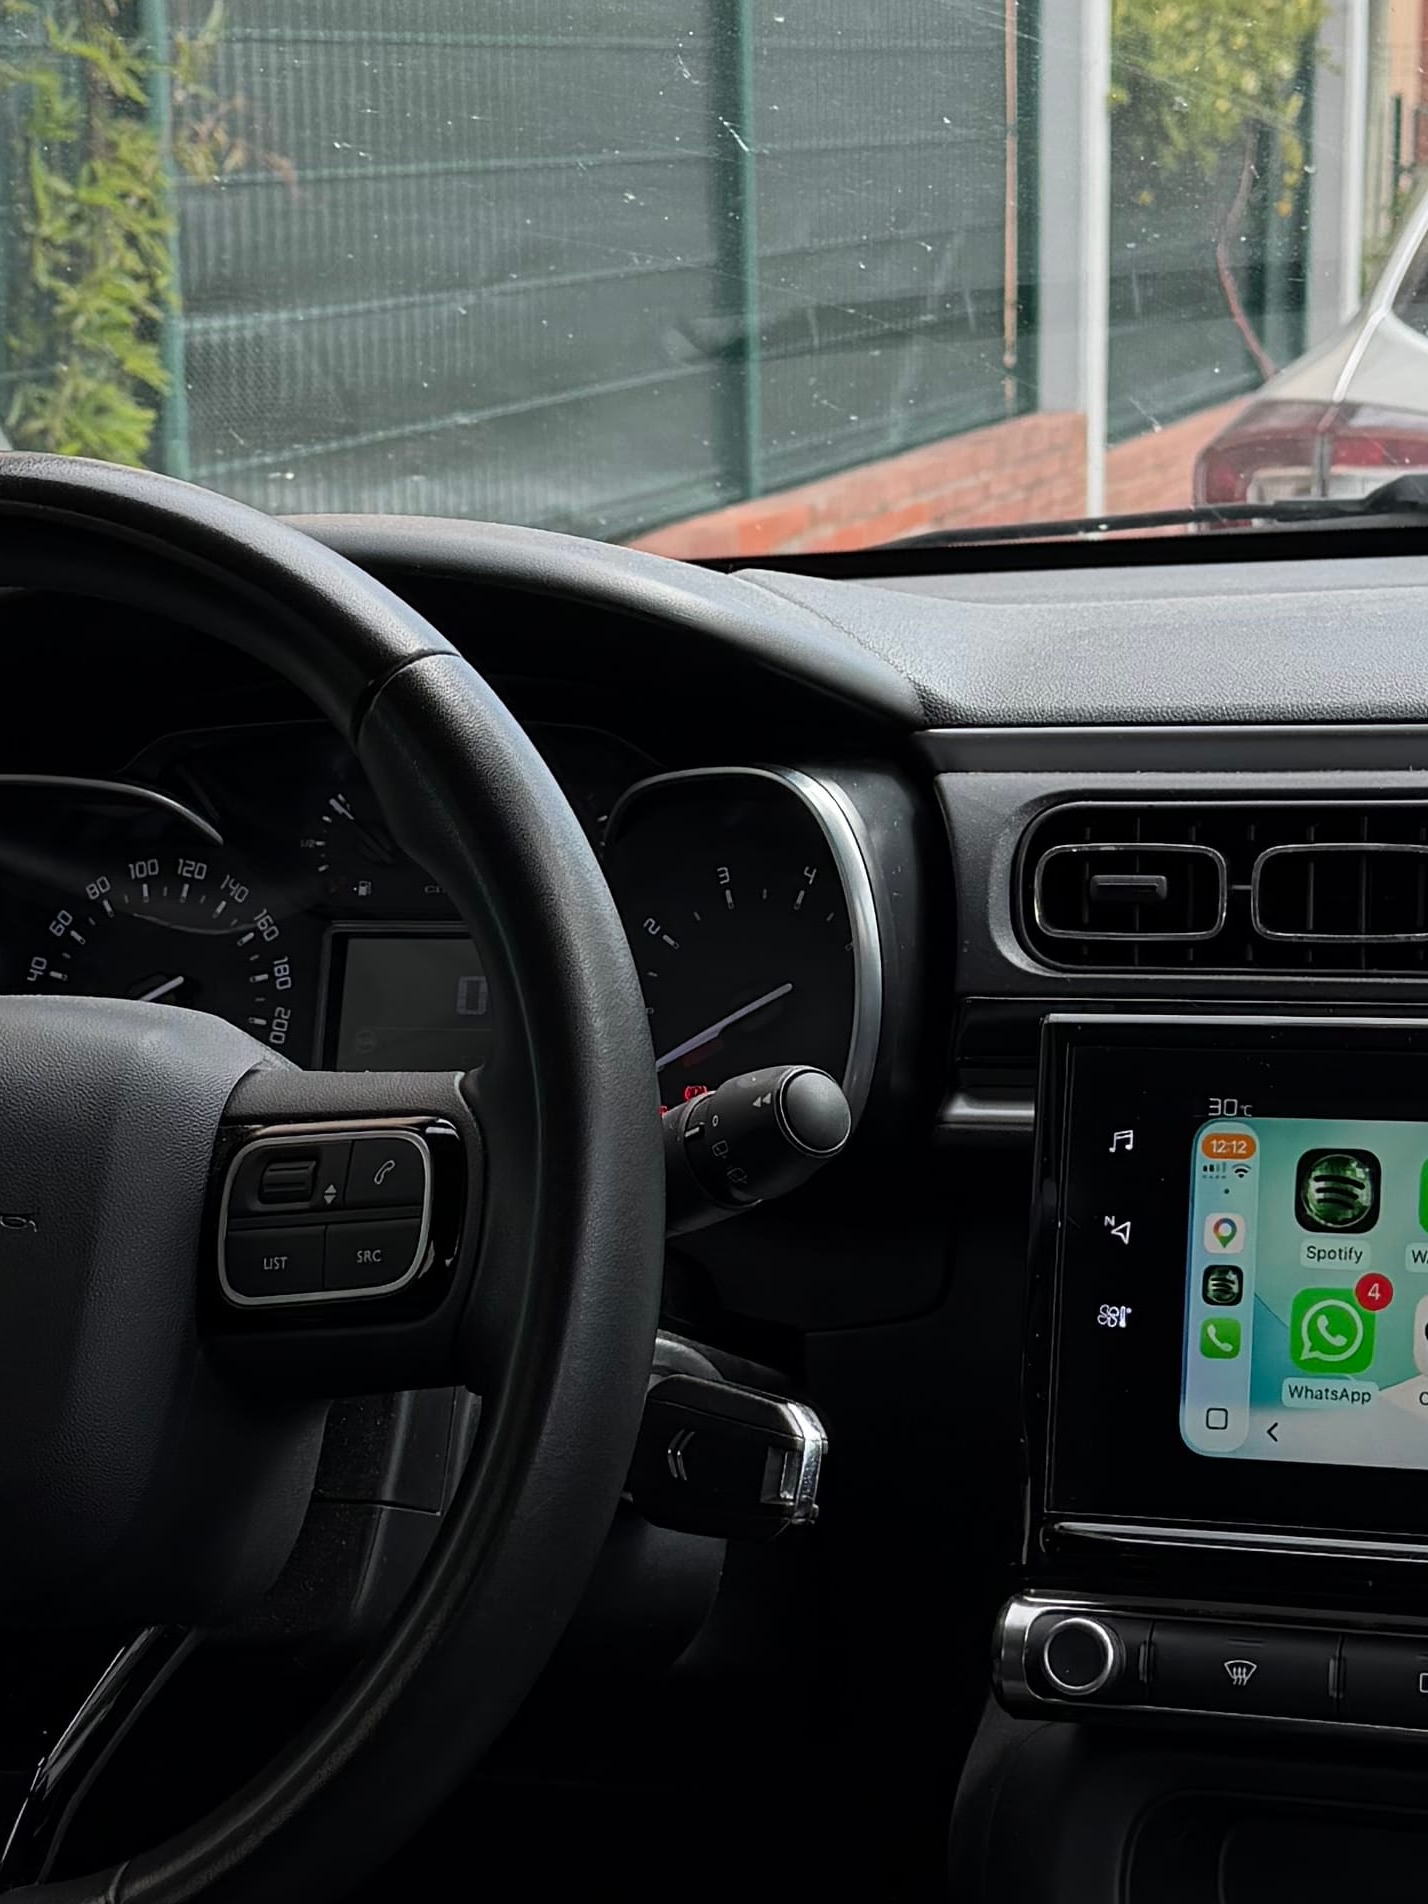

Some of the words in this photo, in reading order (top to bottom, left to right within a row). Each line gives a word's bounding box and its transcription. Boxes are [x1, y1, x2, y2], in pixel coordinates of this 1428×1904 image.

[128, 858, 160, 880] 100
[177, 858, 208, 881] 120
[716, 866, 731, 885] 3
[803, 865, 818, 885] 4
[85, 876, 111, 901] 80
[221, 874, 250, 903] 140
[48, 909, 74, 937] 60
[253, 908, 280, 943] 160
[643, 917, 661, 936] 2
[26, 956, 48, 983] 40
[273, 956, 292, 990] 180
[269, 1006, 291, 1045] 200
[1210, 1139, 1247, 1154] 12:12
[263, 1256, 289, 1271] LIST
[356, 1249, 383, 1264] SRC
[1306, 1246, 1363, 1264] Spotify
[1367, 1283, 1381, 1300] 4
[1288, 1385, 1372, 1404] WhatsApp
